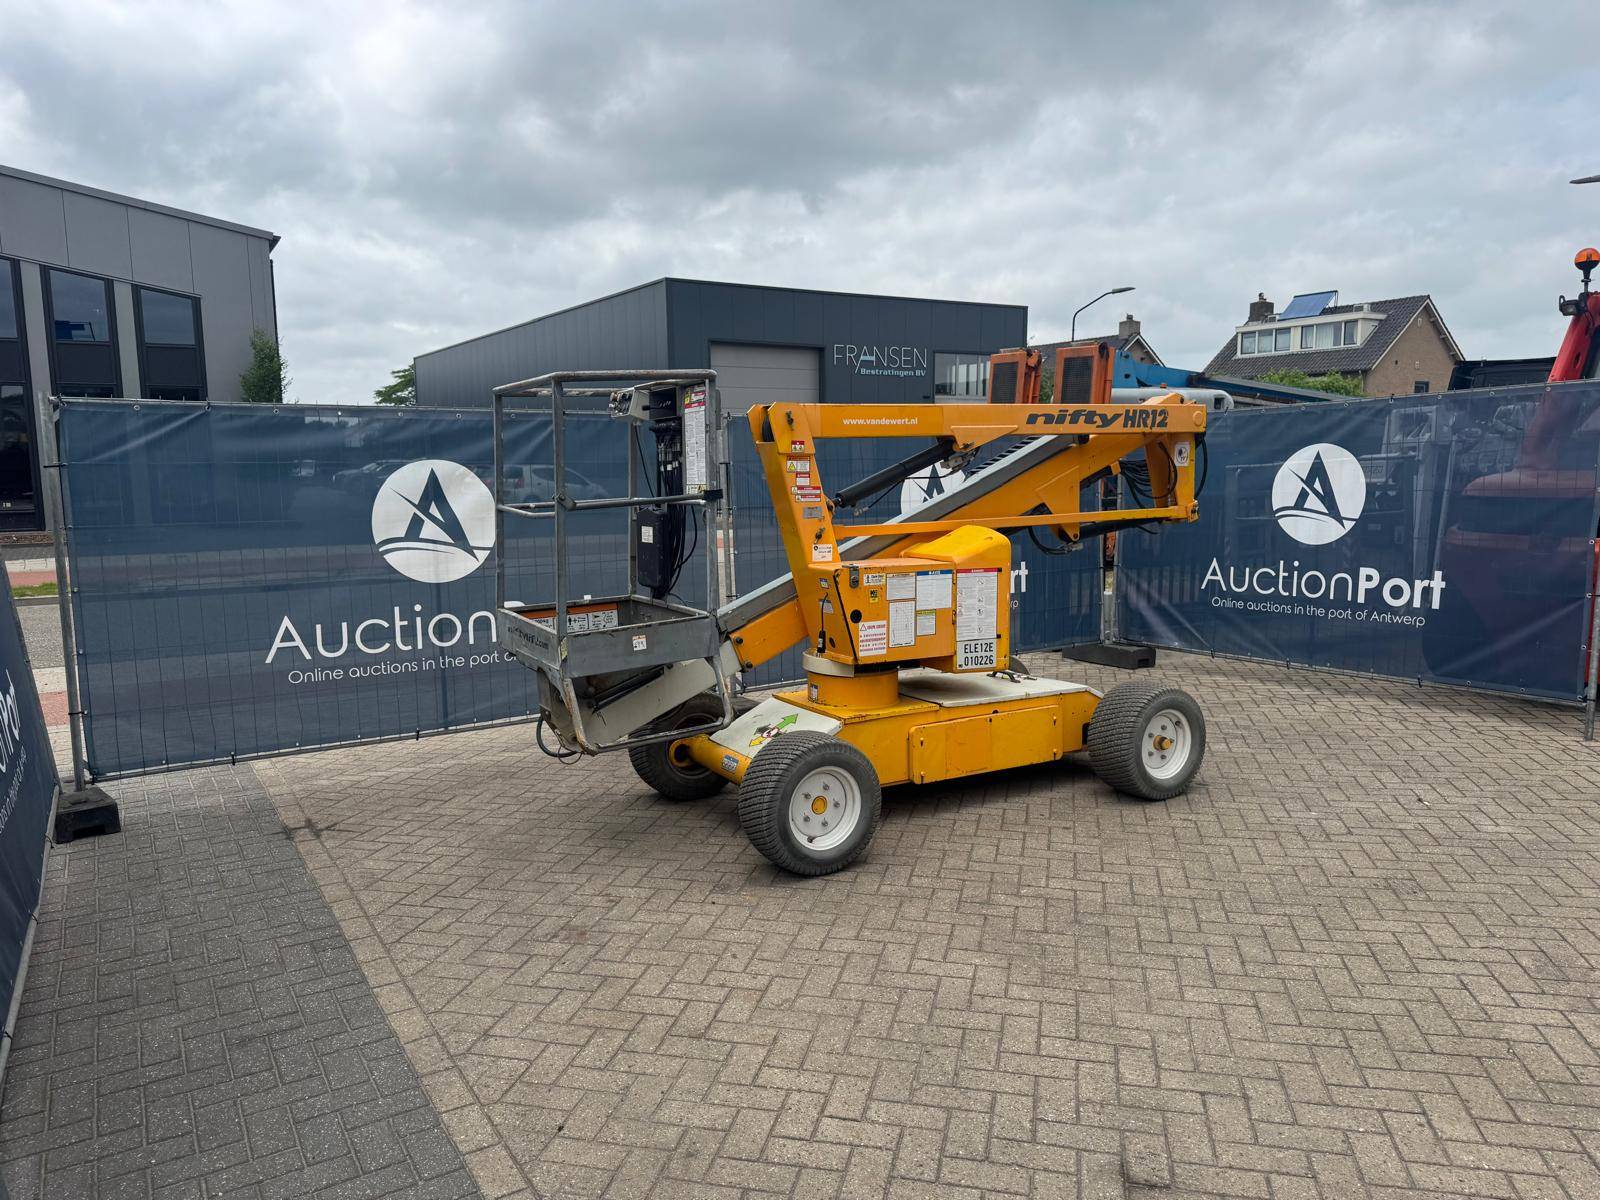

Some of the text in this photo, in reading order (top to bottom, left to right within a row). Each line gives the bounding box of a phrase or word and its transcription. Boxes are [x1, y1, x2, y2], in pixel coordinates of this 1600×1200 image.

[833, 344, 927, 374] FRANSEN
[860, 368, 927, 378] Bestratingen BV
[842, 417, 918, 425] www.vandewert.nl
[1026, 409, 1168, 428] nifty HR12
[1200, 557, 1446, 610] AuctionPort
[1211, 596, 1425, 628] Online auctions in the port of Antwerp
[265, 601, 526, 663] Auction
[963, 642, 994, 654] ELE12E
[288, 668, 343, 684] Online
[349, 661, 418, 678] auctions
[422, 658, 436, 671] in
[440, 655, 465, 669] the
[470, 650, 499, 668] port
[964, 655, 994, 667] 010226
